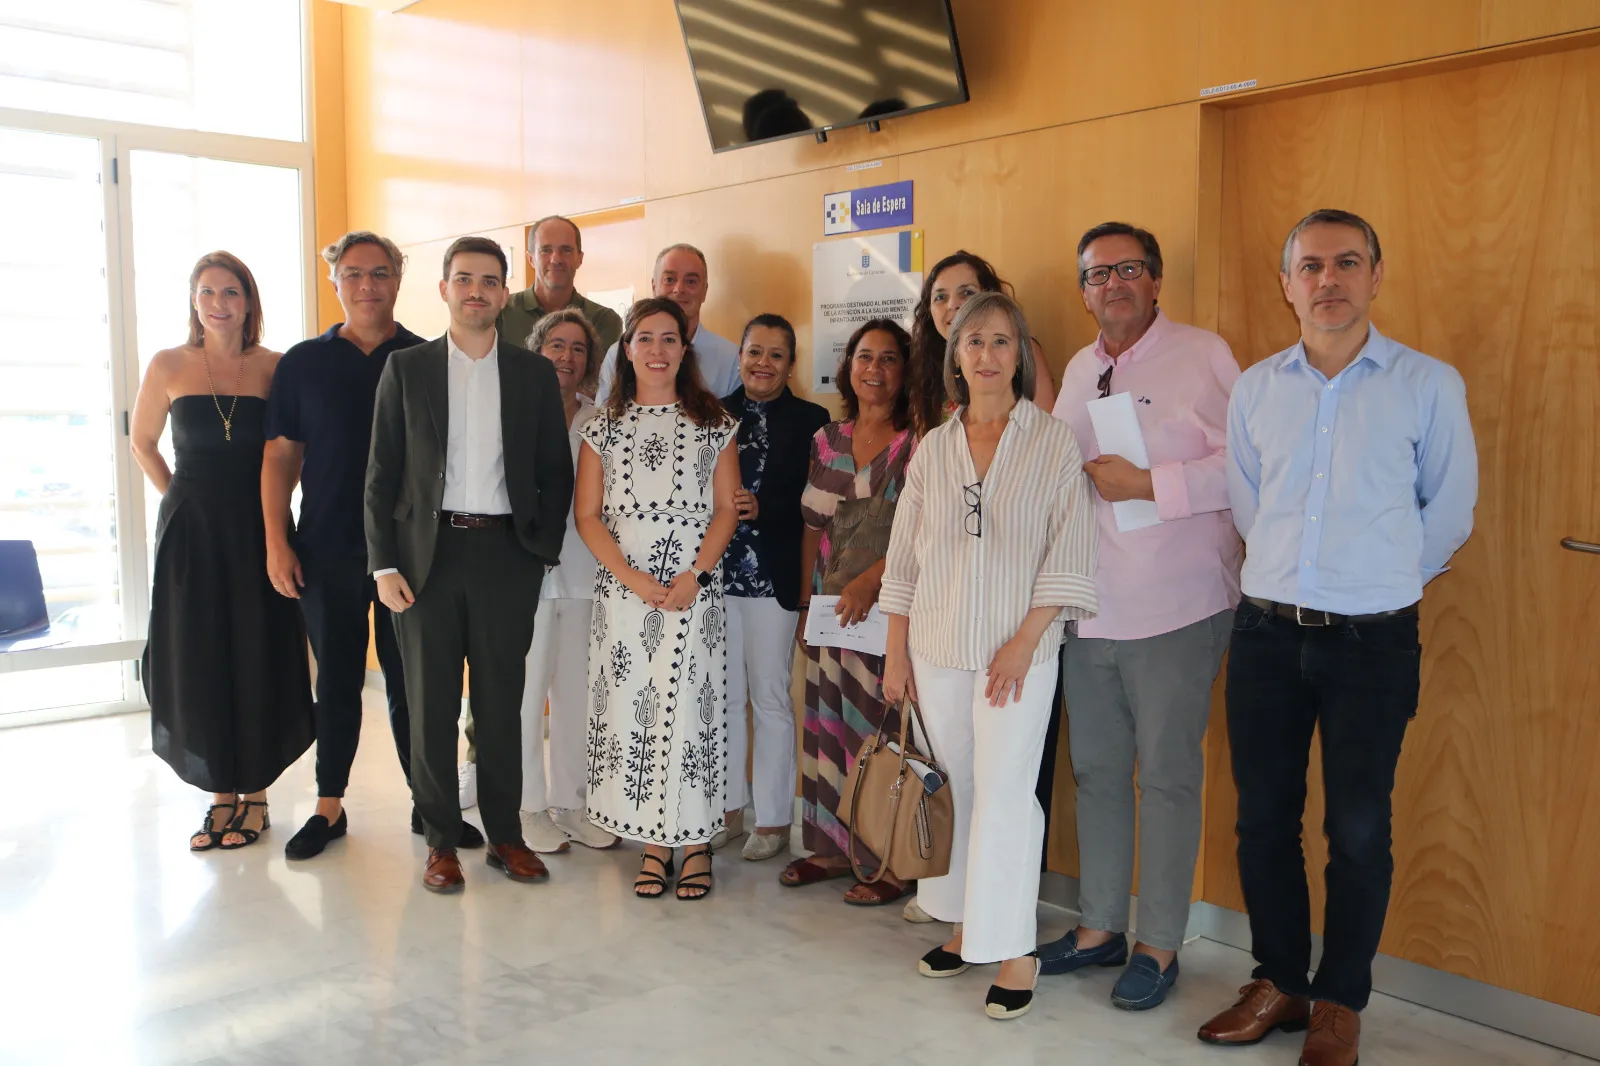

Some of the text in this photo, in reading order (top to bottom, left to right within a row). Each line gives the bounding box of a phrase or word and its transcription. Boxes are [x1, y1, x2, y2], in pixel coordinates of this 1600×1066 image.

[856, 196, 906, 216] Sala de Espera
[820, 302, 846, 310] PROGRAMA
[881, 298, 914, 306] INCREMENTO
